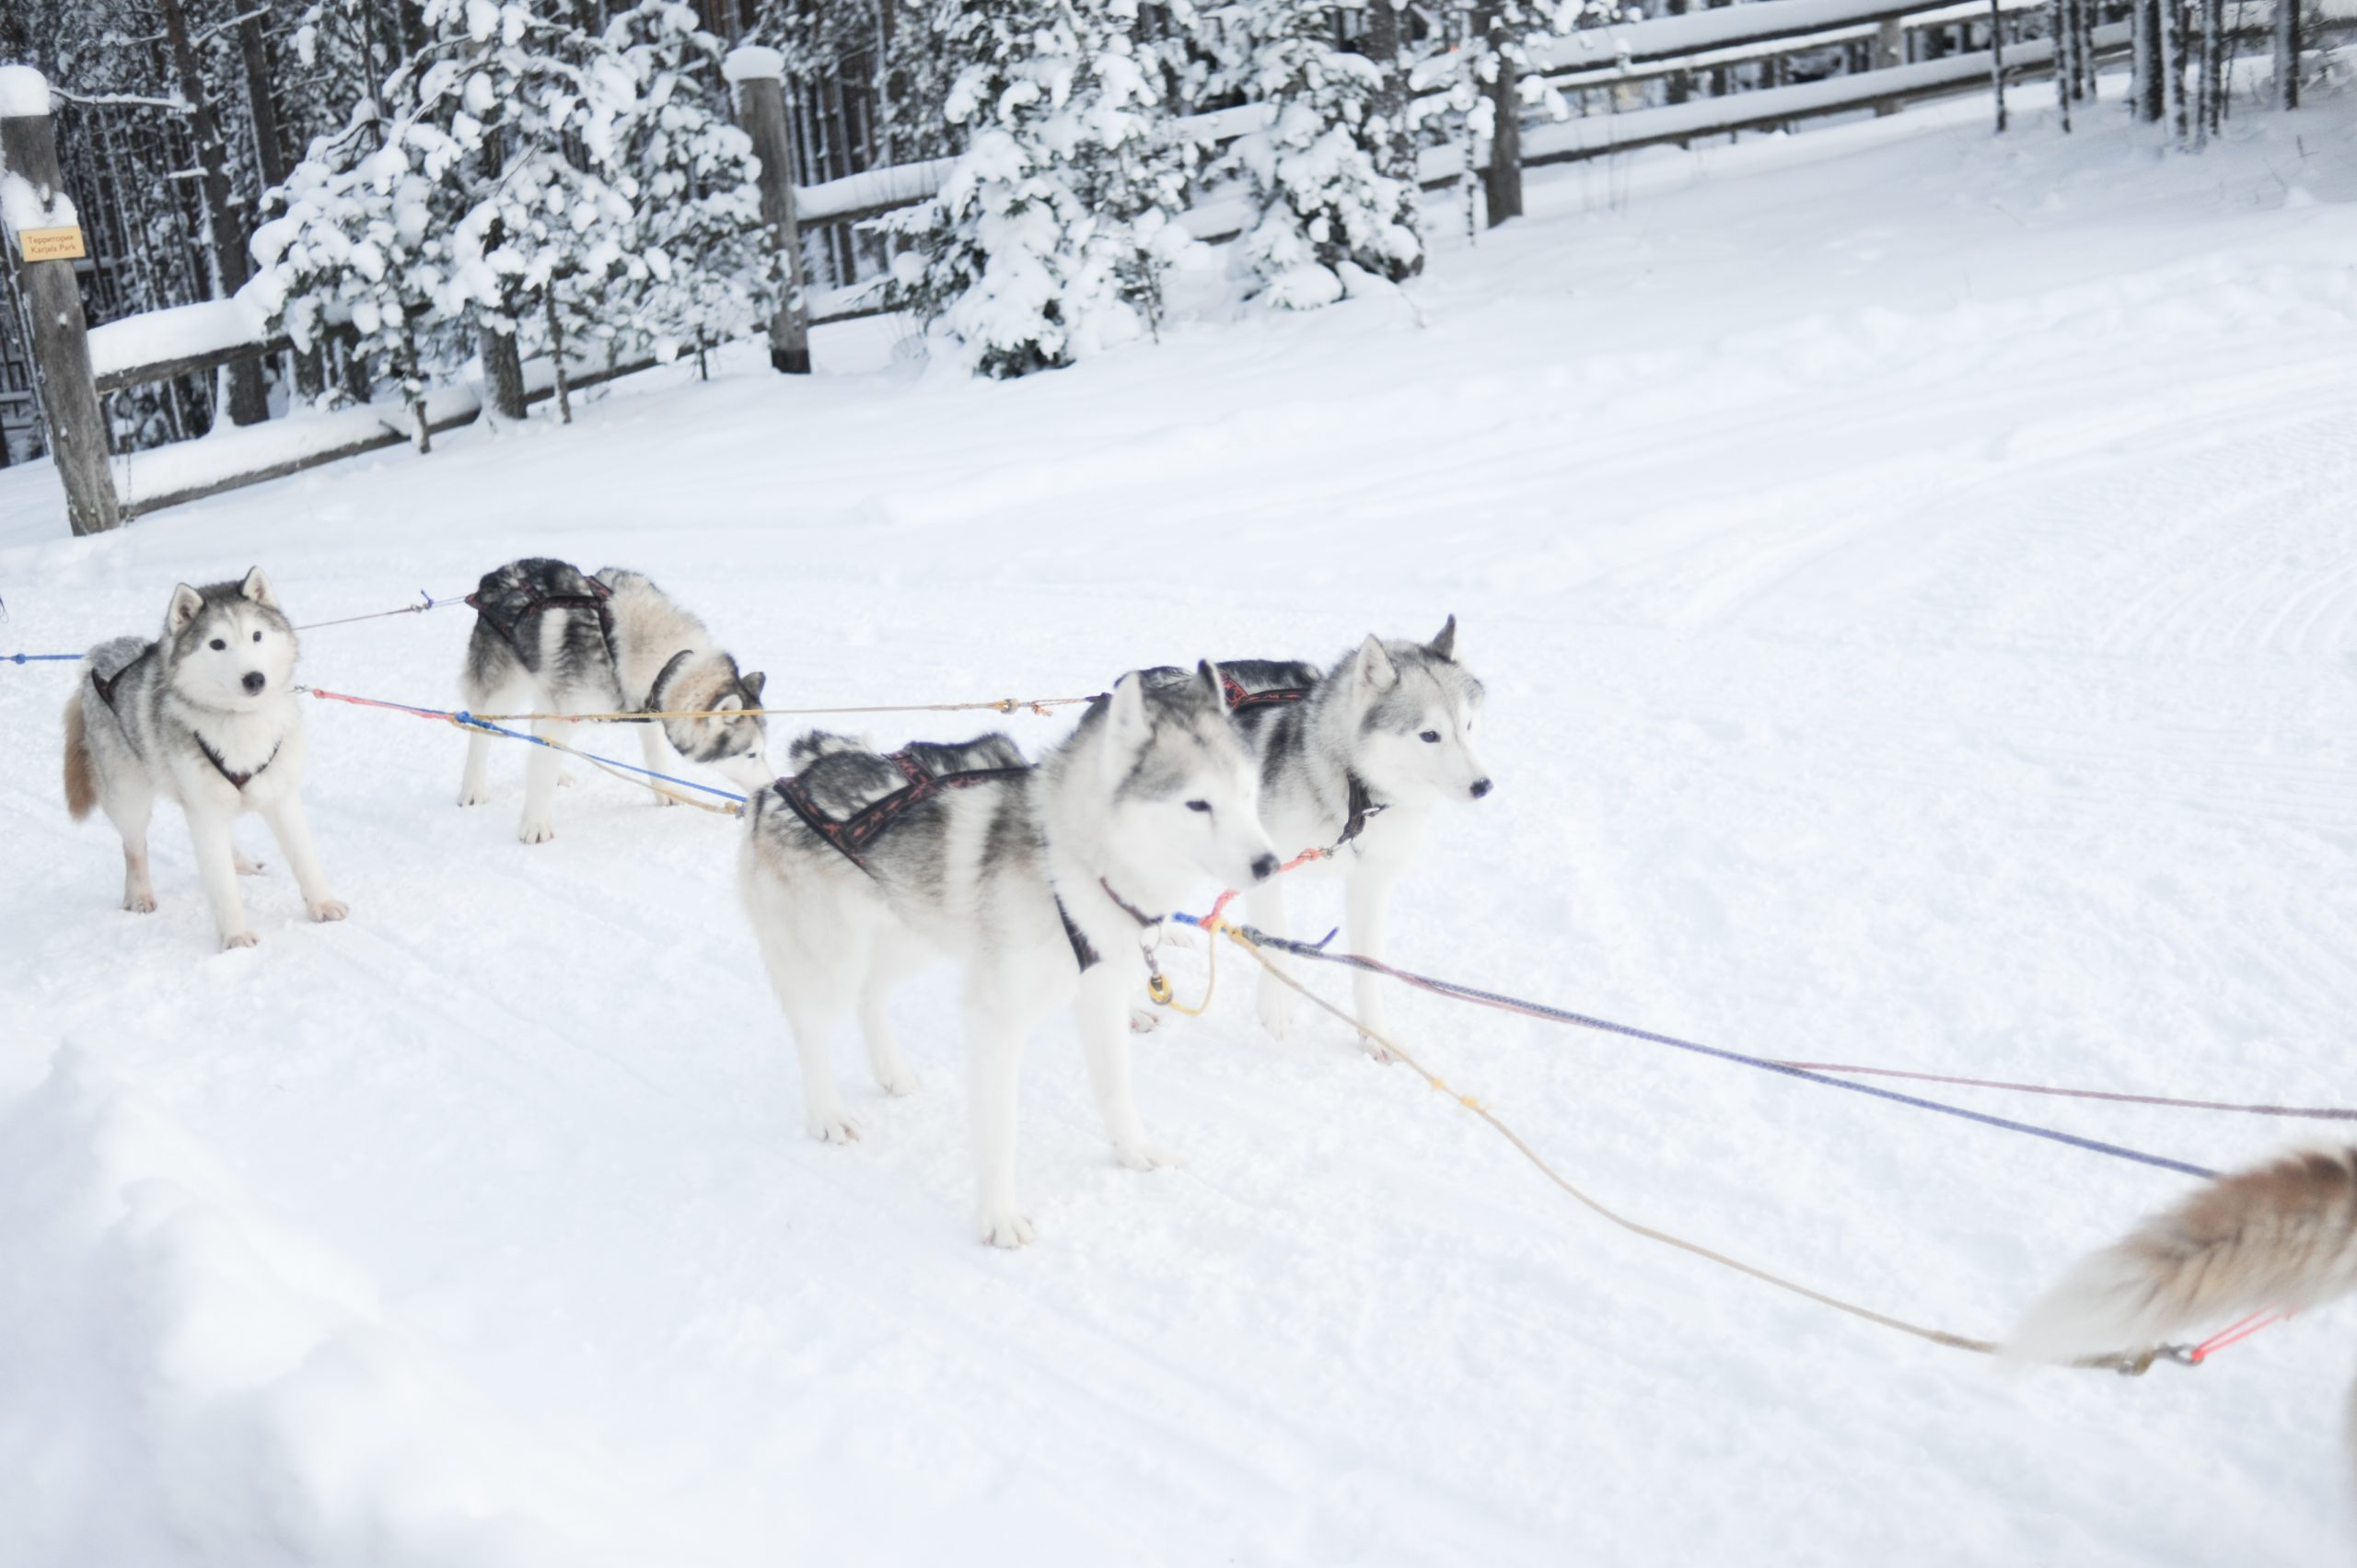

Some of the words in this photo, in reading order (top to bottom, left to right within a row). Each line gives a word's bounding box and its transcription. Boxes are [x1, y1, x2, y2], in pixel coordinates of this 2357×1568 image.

[28, 235, 74, 245] Территория
[30, 244, 57, 254] Karjala
[59, 243, 75, 251] Park
